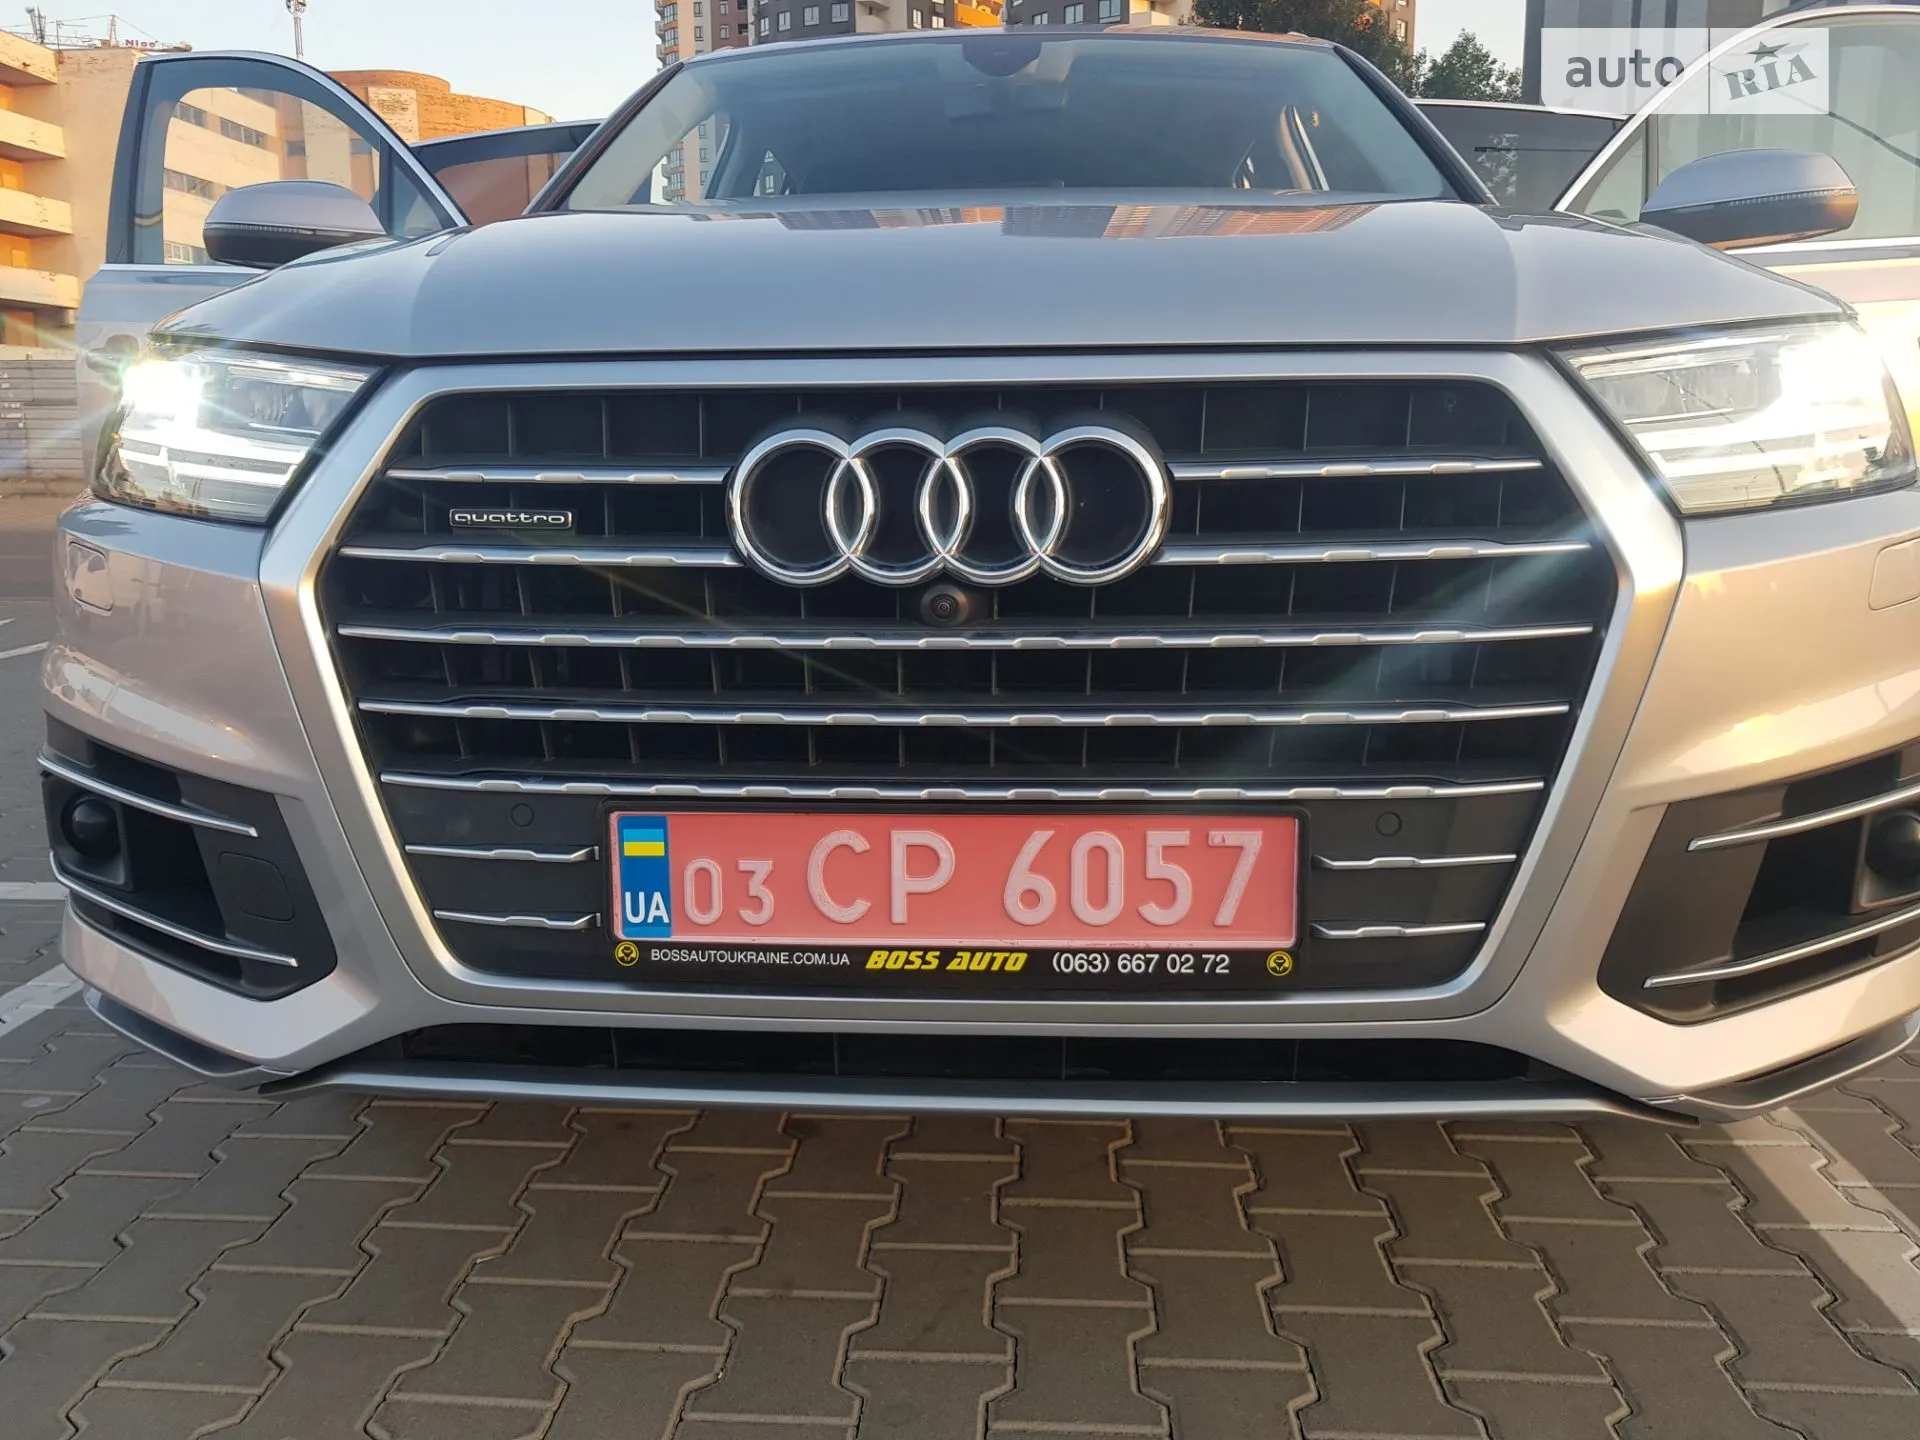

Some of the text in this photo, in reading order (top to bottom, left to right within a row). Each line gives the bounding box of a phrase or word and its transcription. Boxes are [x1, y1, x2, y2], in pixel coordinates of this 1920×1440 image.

[454, 512, 565, 525] quattro
[683, 856, 775, 926] 03
[1004, 829, 1263, 926] 6057
[625, 891, 671, 924] UA
[650, 948, 1230, 974] BOSSAUTOUKRAINE.COM.UA BOSS AUTO (063) 667 02 72
